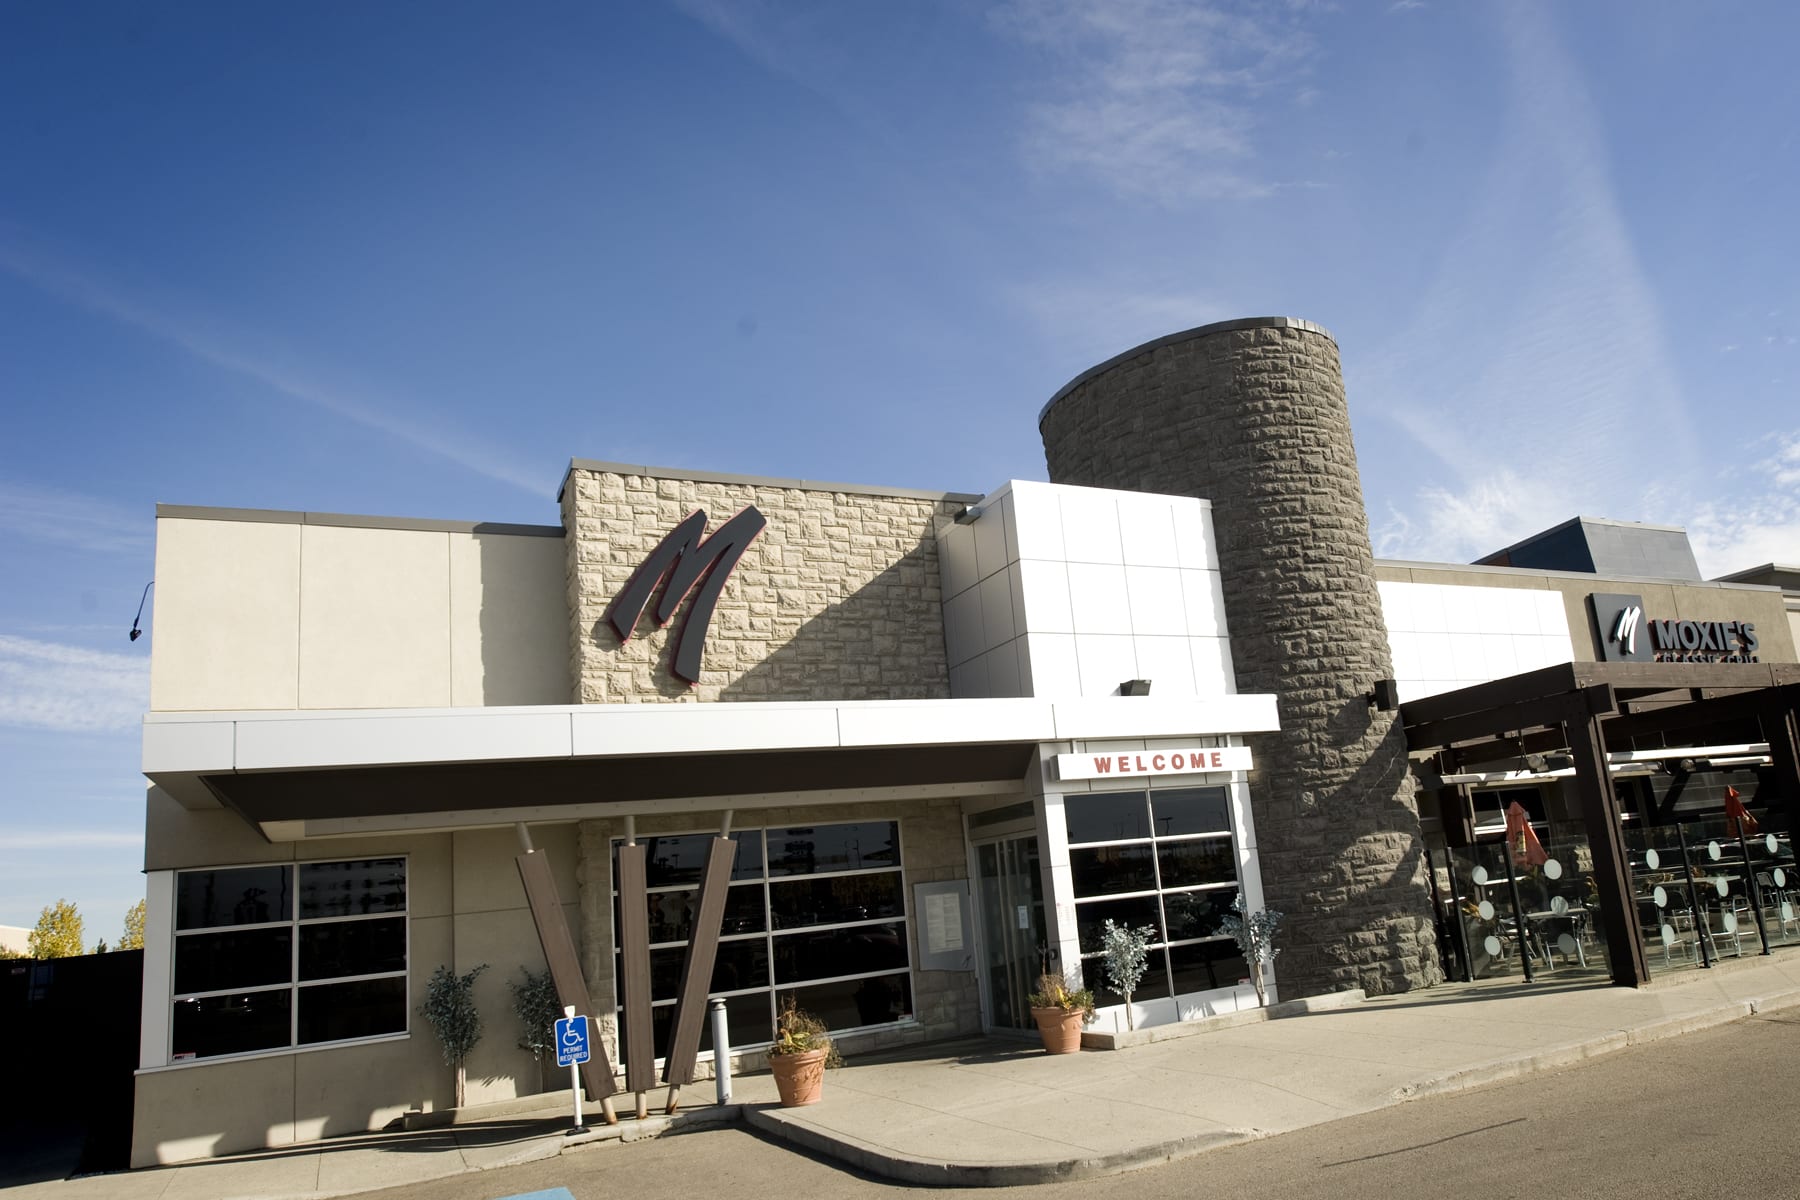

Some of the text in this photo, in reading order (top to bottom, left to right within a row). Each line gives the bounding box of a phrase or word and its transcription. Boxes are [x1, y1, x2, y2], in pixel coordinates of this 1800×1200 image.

[611, 505, 767, 686] M
[1654, 618, 1759, 651] MOXIE'S
[1094, 752, 1222, 773] WELCOME
[560, 1051, 588, 1062] REQUIRED
[563, 1045, 583, 1054] PERMIT
